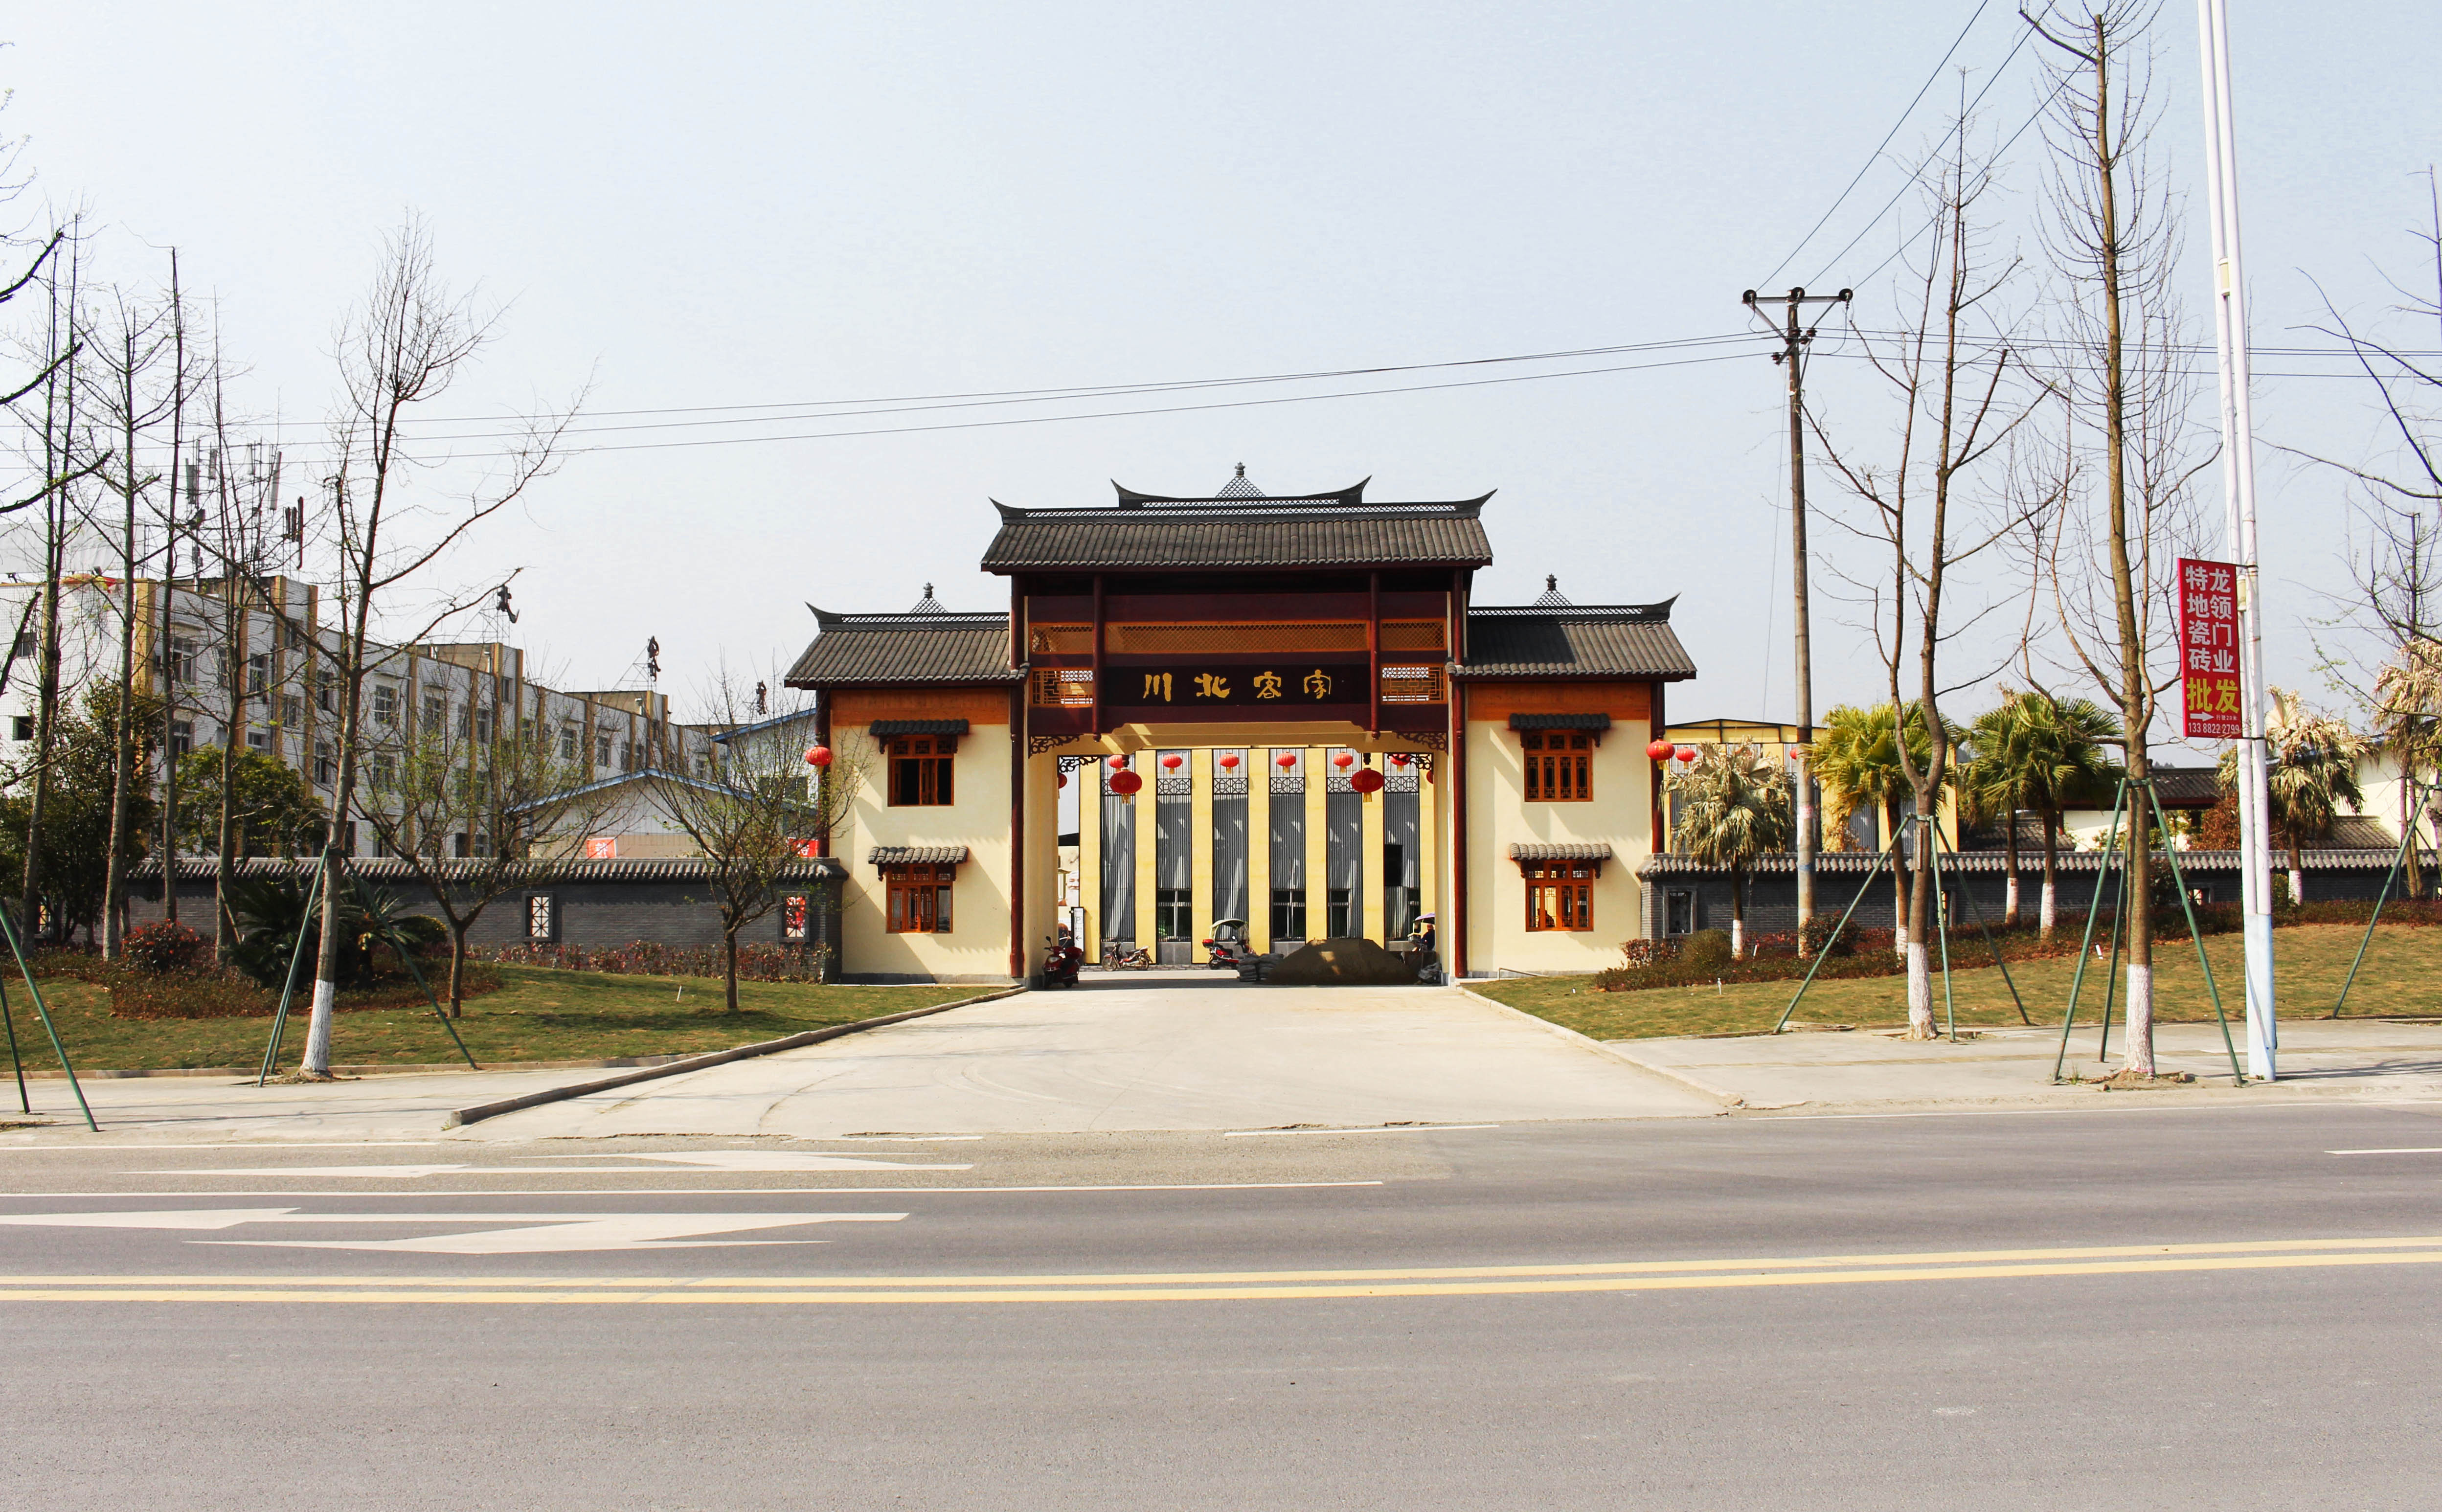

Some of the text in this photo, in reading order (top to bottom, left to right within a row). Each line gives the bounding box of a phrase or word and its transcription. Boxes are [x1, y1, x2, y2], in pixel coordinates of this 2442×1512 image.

[2185, 565, 2211, 673] 特地瓷砖
[2210, 568, 2234, 673] 龙领门业
[2187, 677, 2239, 713] 批发
[2188, 722, 2201, 733] 133
[2203, 723, 2220, 734] 8822
